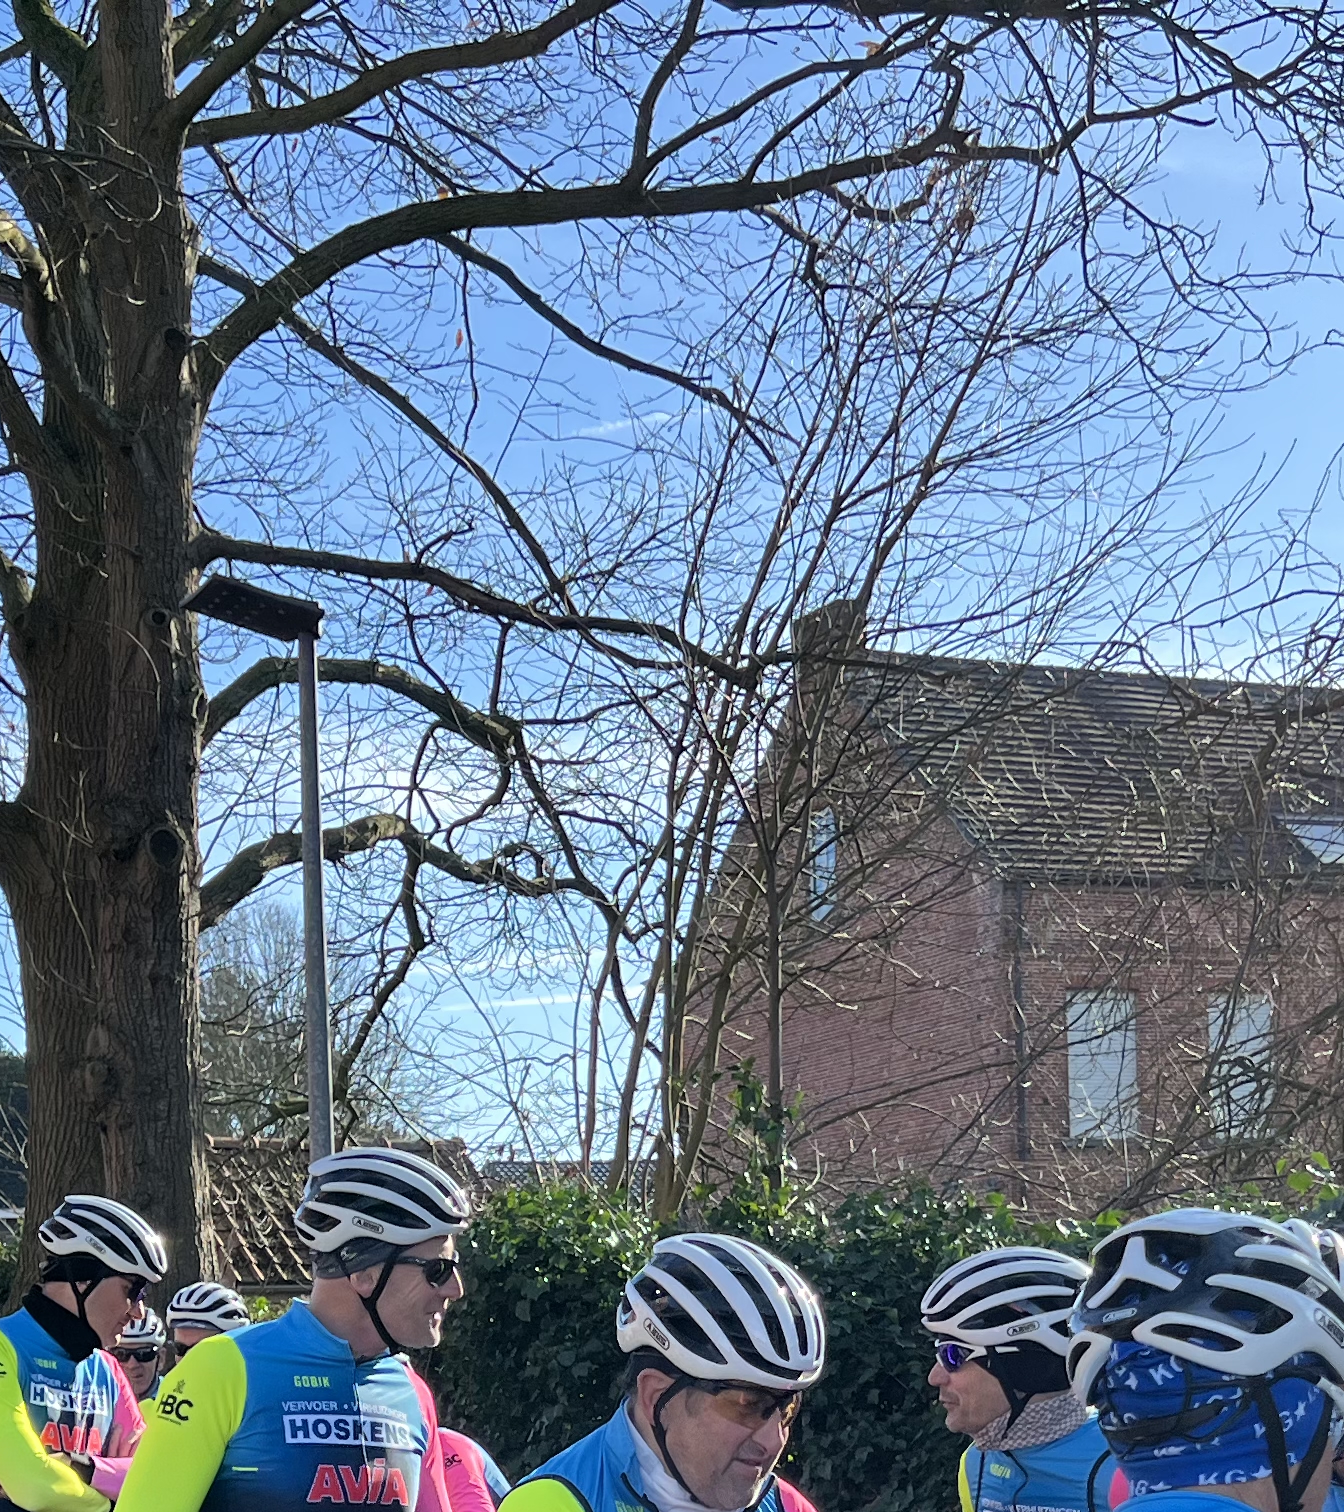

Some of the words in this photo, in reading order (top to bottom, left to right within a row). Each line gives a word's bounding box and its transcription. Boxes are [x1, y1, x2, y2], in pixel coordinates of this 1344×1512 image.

[292, 1375, 332, 1389] GOBIK
[281, 1401, 339, 1412] VERVOER
[289, 1418, 410, 1447] HOSKENS
[306, 1457, 410, 1507] AVIA
